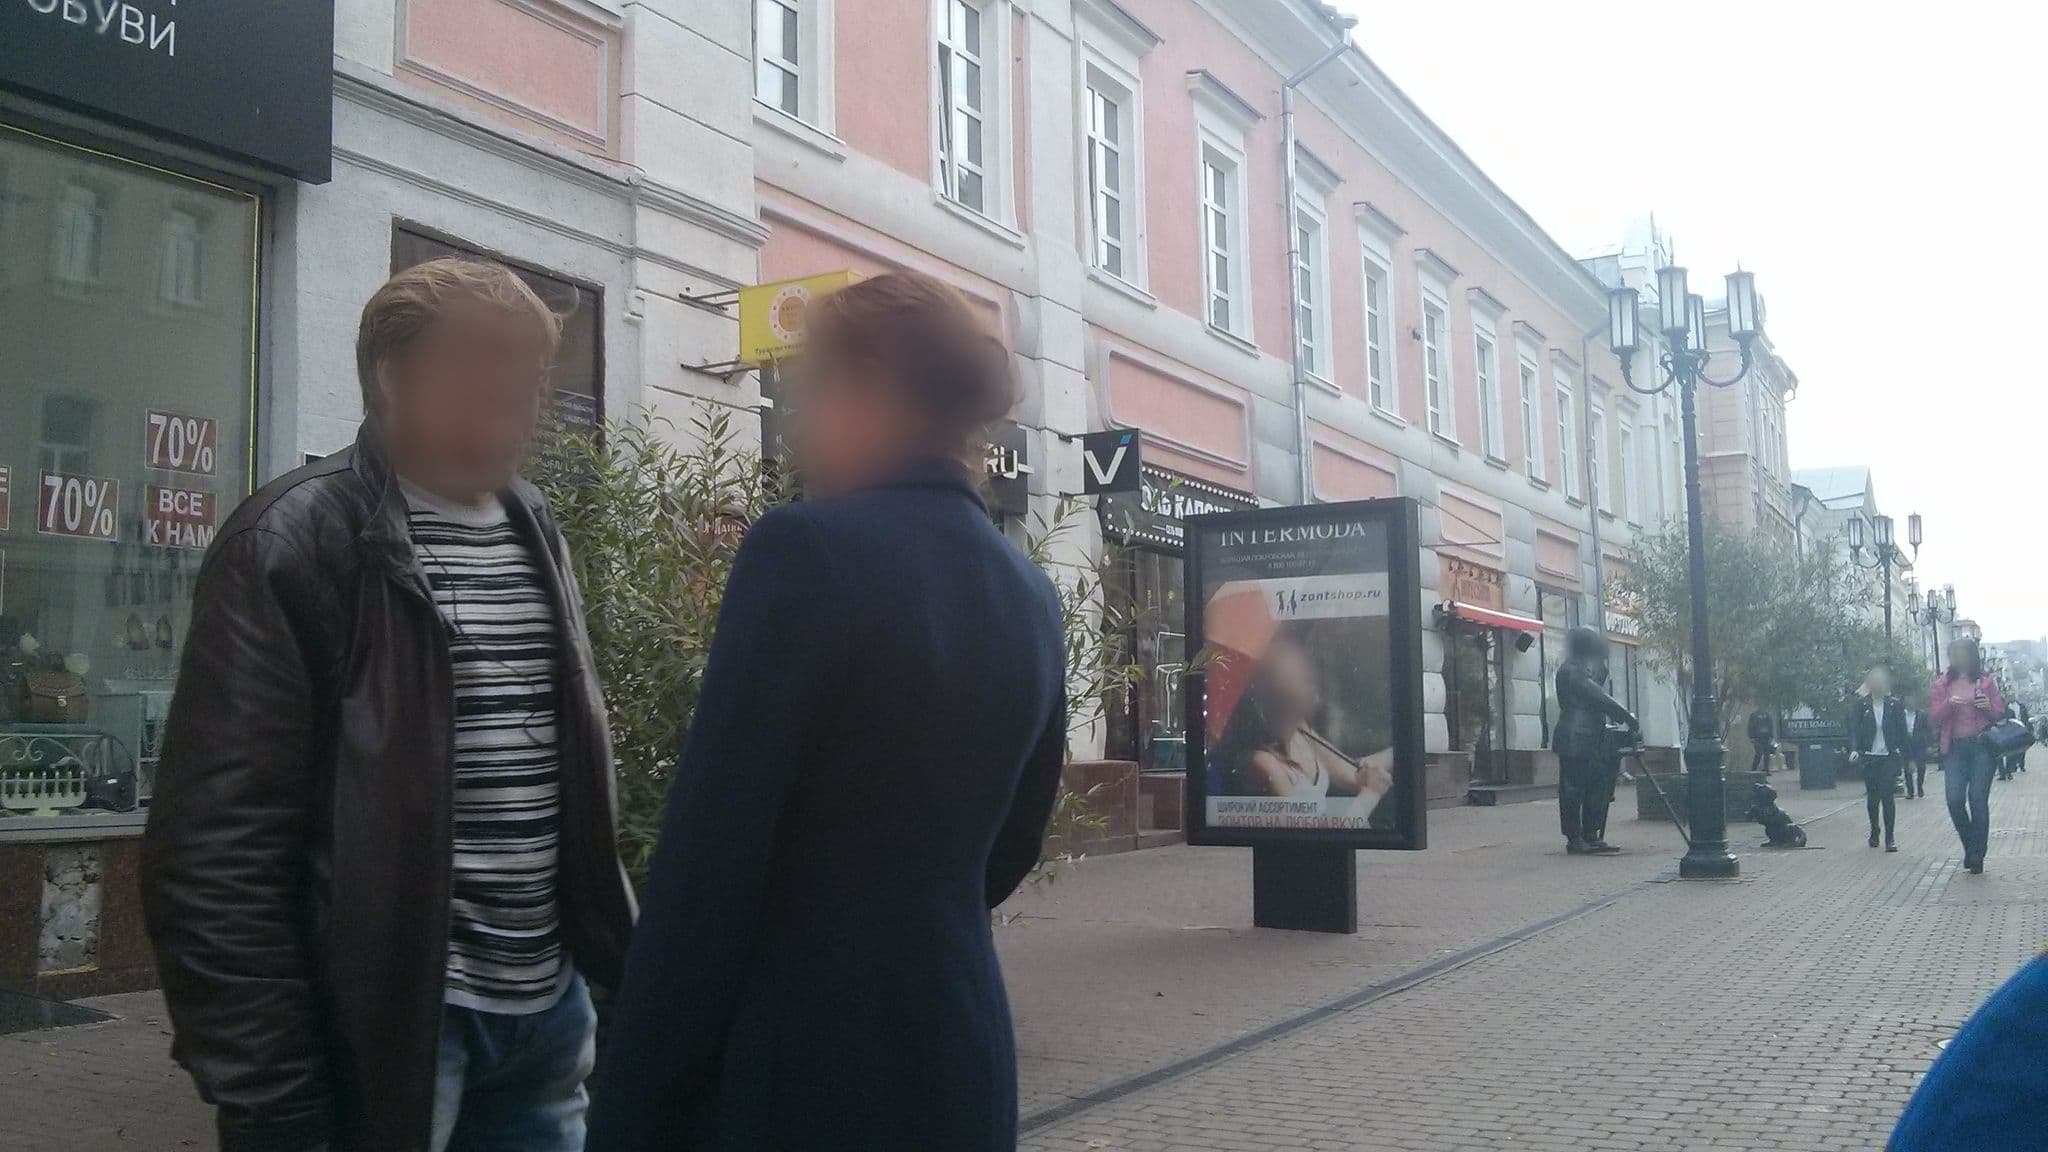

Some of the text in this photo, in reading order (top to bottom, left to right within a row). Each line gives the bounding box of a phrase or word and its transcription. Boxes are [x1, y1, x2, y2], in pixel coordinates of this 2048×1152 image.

[150, 414, 213, 473] 70%
[44, 475, 113, 536] 70%
[159, 488, 204, 517] ВСЕ
[166, 520, 214, 548] НАМ
[1220, 521, 1366, 547] INTERMODA
[1300, 588, 1382, 602] zontshop.ru
[1258, 801, 1318, 813] АССОРТИМЕНТ
